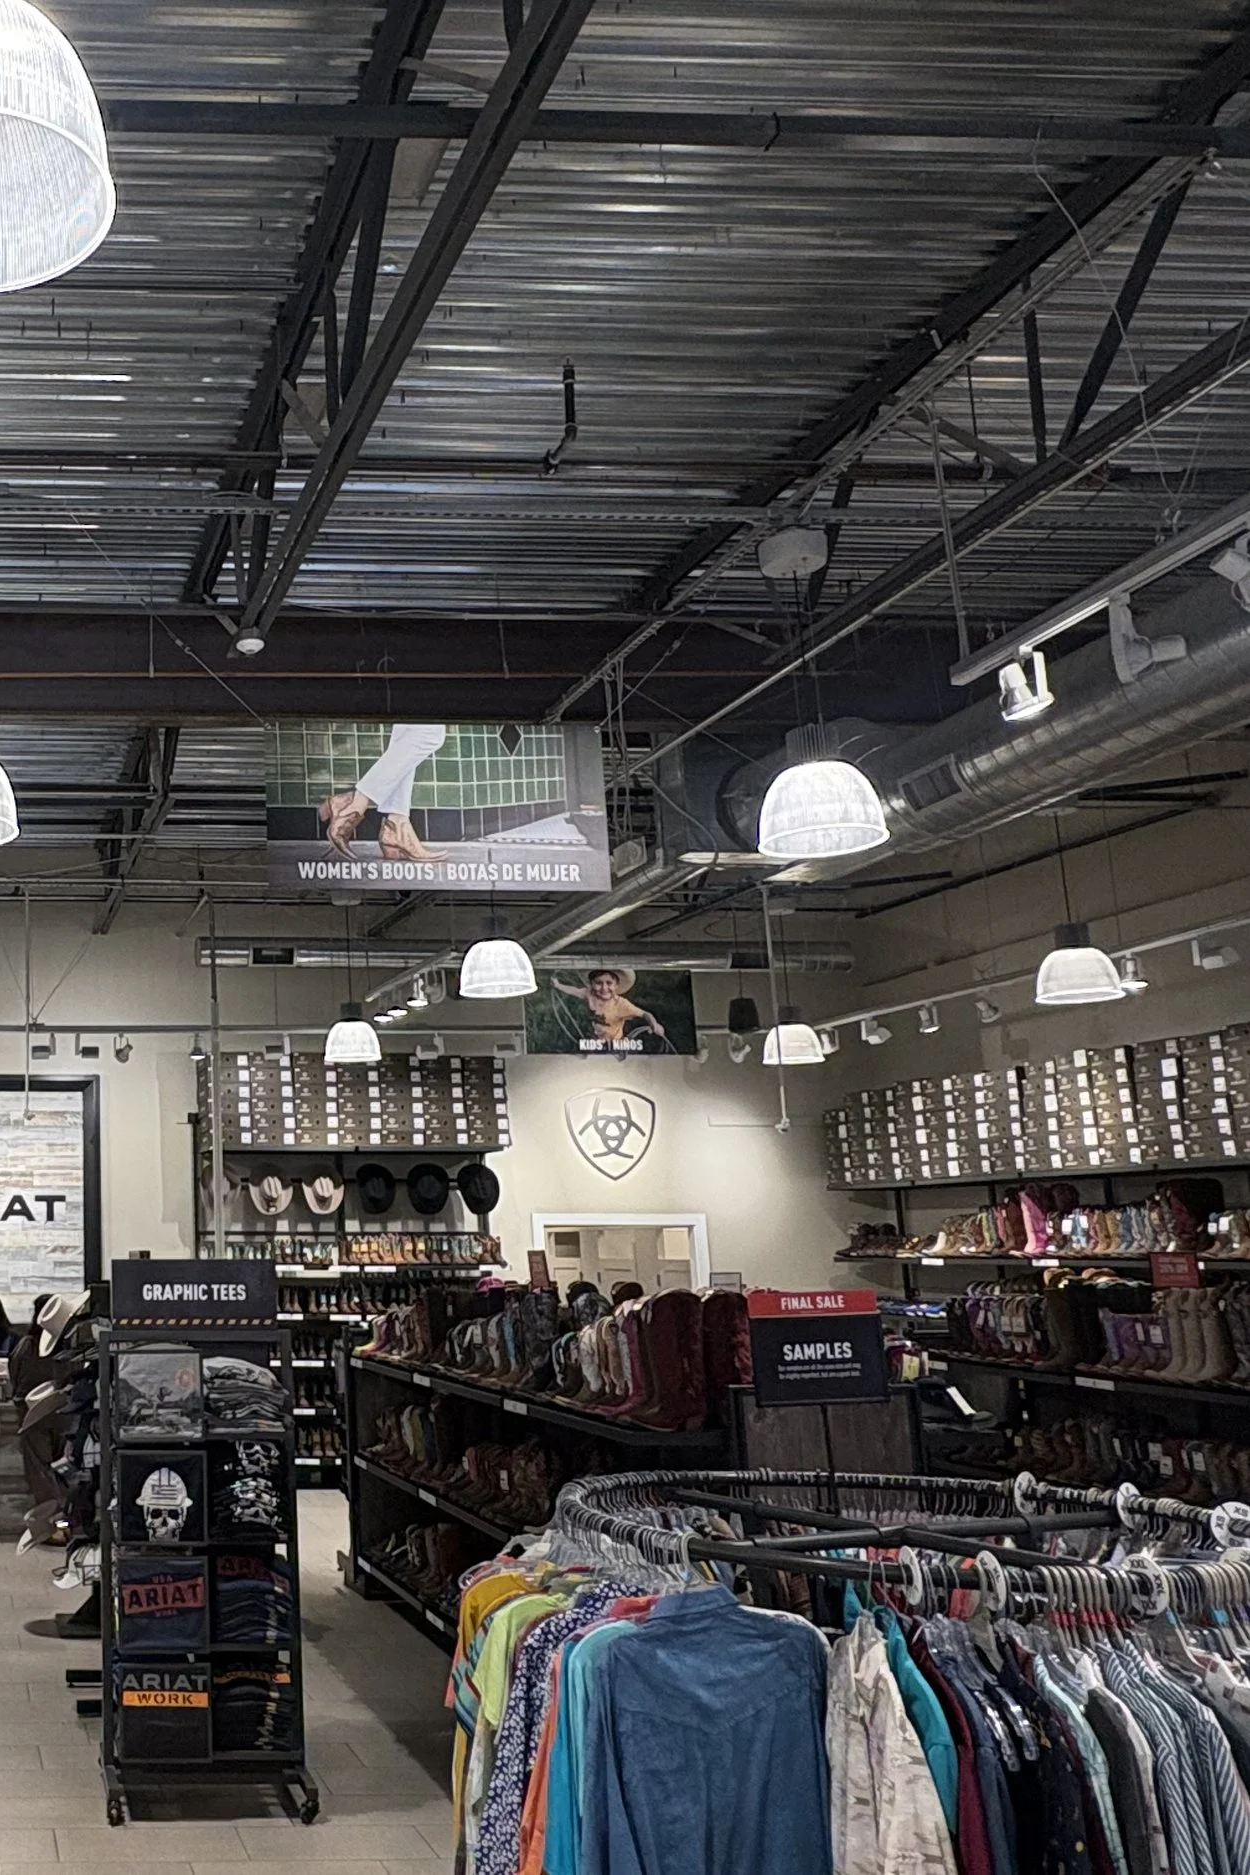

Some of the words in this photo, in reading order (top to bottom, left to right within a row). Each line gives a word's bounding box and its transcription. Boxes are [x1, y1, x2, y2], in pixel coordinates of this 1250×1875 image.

[298, 861, 379, 880] WOMEN'S
[382, 862, 435, 881] BOOTS
[447, 862, 499, 882] BOTAS
[502, 863, 528, 882] DE
[531, 863, 582, 883] MUJER
[142, 1283, 208, 1301] GRAPHIC
[211, 1283, 247, 1301] TEES
[781, 1296, 815, 1310] FINAL
[816, 1295, 845, 1309] SALE
[783, 1341, 853, 1361] SAMPLES
[1233, 1506, 1249, 1517] XS
[128, 1583, 202, 1609] ARIAT
[122, 1673, 208, 1691] ARIAT
[137, 1693, 194, 1705] WORK
